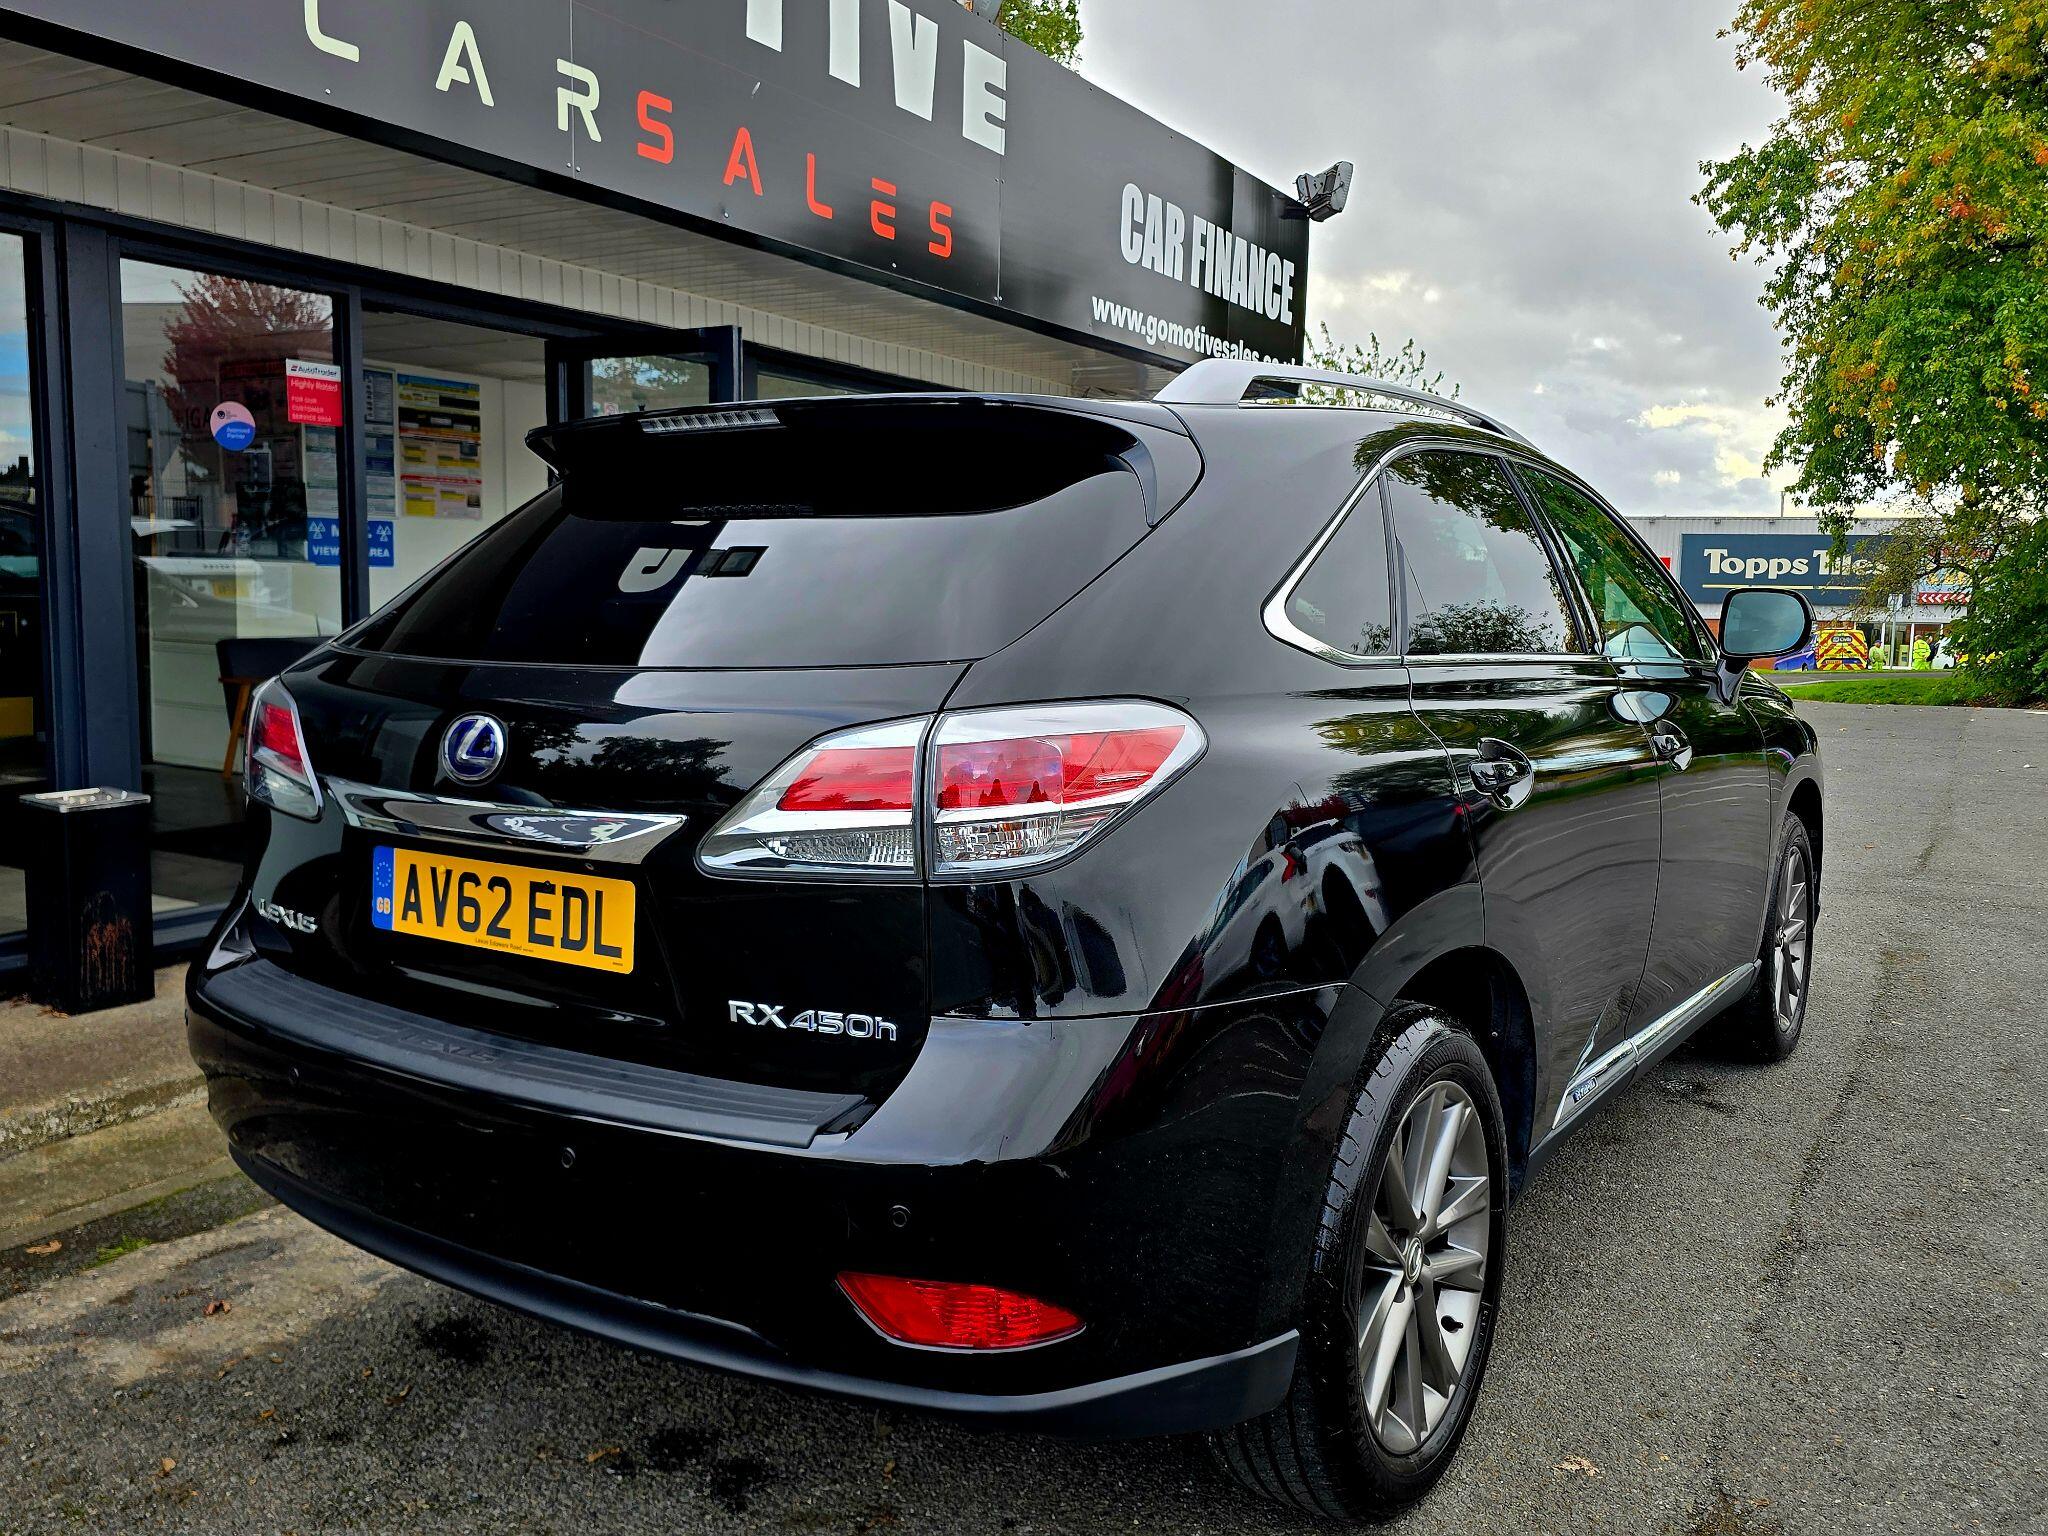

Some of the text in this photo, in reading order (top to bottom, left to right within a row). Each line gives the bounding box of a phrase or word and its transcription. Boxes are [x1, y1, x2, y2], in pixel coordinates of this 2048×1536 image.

[746, 0, 1007, 156] IVE
[1120, 182, 1295, 326] CAR FINANCE
[368, 546, 390, 558] REA
[1703, 548, 1809, 580] Topps
[259, 898, 318, 933] LEXUS
[376, 896, 391, 915] GB
[401, 863, 623, 959] AV62 EDL
